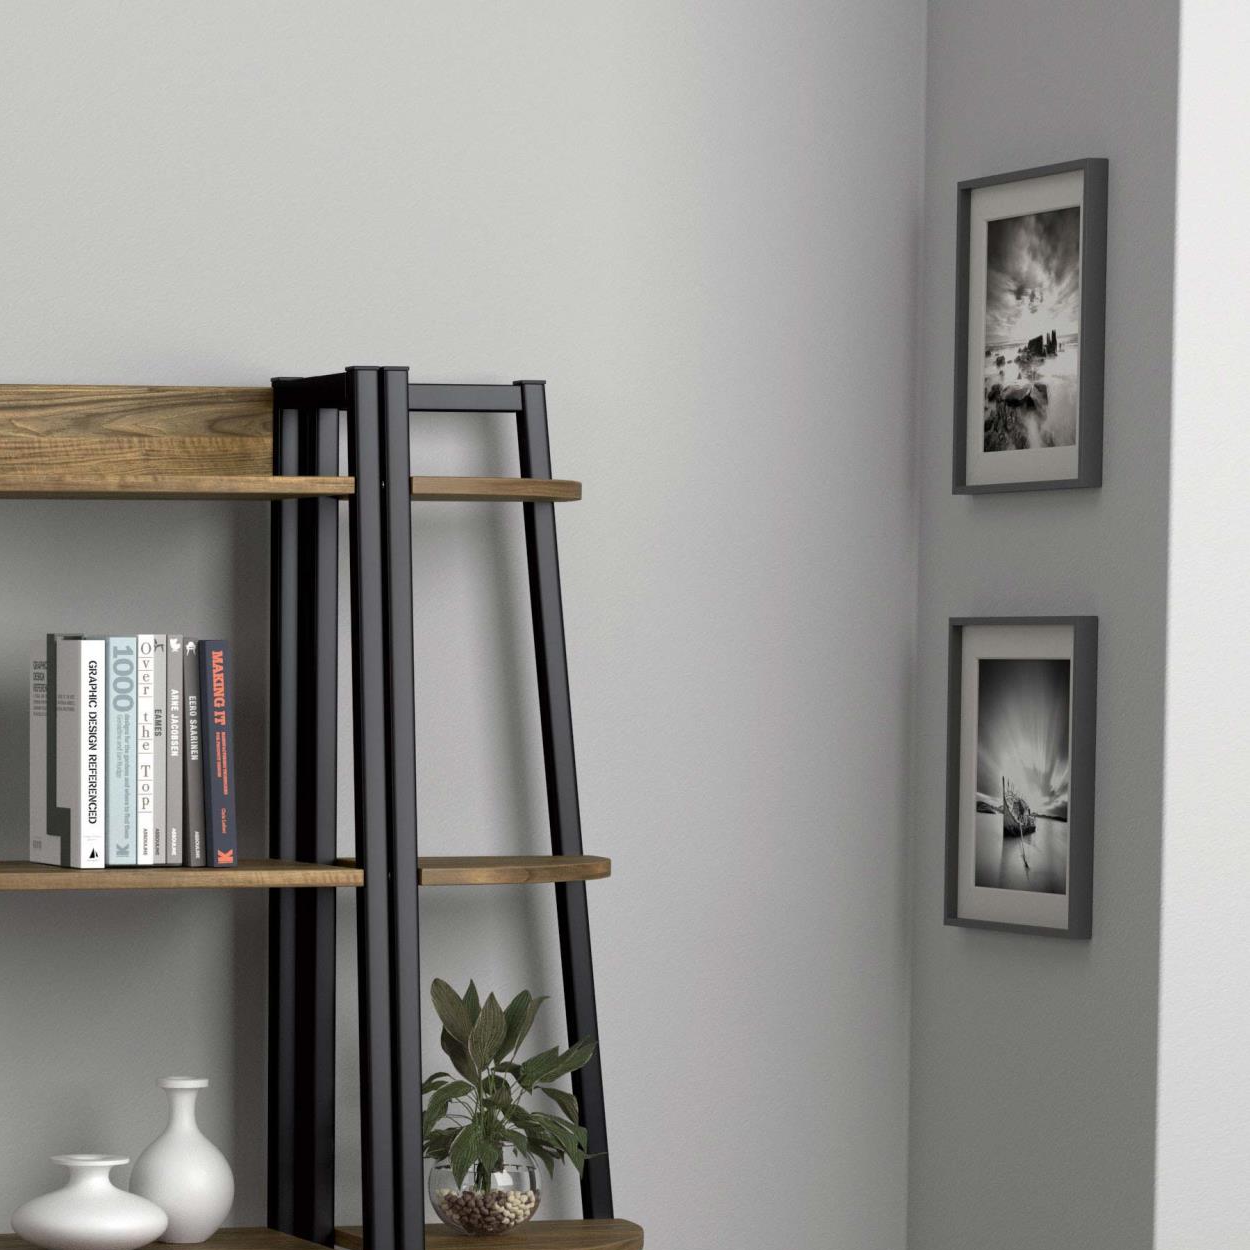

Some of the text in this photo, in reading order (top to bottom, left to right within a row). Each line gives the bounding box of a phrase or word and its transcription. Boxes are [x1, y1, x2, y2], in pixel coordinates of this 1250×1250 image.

[112, 645, 134, 712] 1000
[140, 642, 151, 696] Over
[212, 651, 224, 707] MAKING
[88, 660, 98, 824] GRAPHIC DESIGN REFERENCED
[141, 712, 150, 751] the
[154, 709, 162, 737] EAMES
[170, 689, 179, 756] ARNE JACOBSEN
[188, 696, 199, 760] EERO SAARINEN
[214, 711, 225, 725] IT
